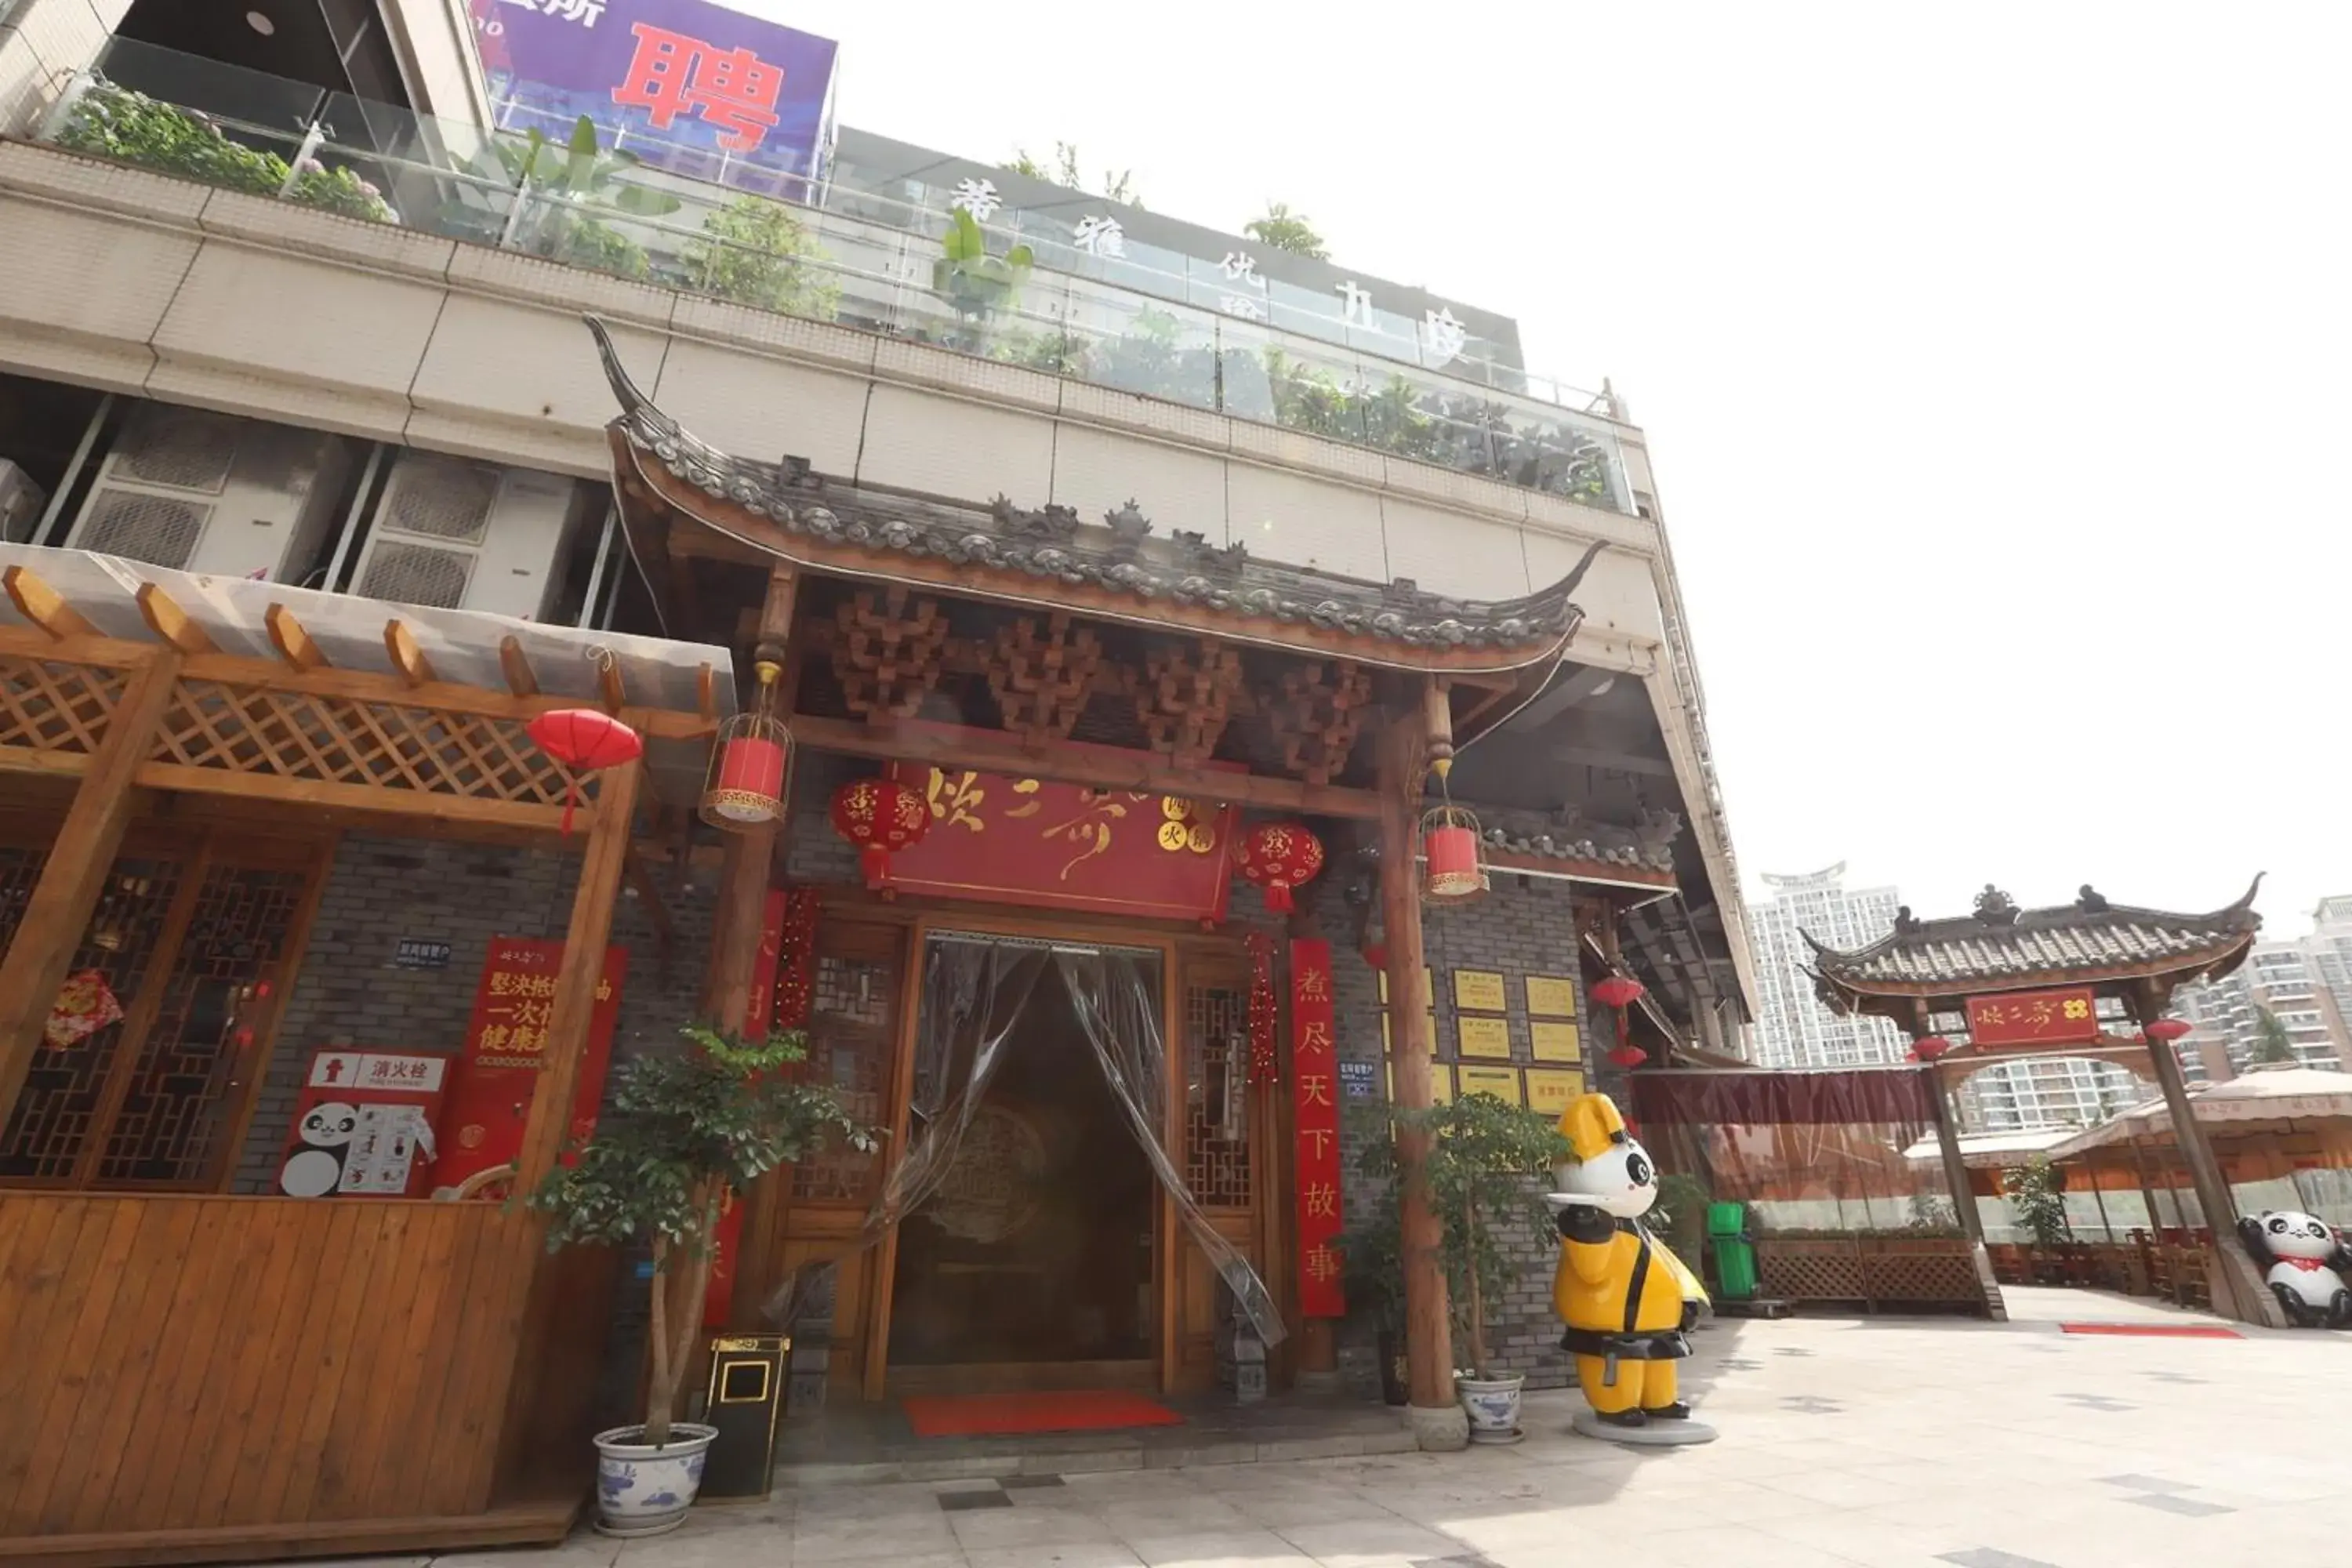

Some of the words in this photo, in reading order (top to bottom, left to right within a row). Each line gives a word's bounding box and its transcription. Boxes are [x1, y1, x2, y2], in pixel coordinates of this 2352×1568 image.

[612, 21, 783, 152] 聘
[371, 1060, 428, 1079] 消火栓
[1294, 967, 1341, 1283] 煮尽天下故事
